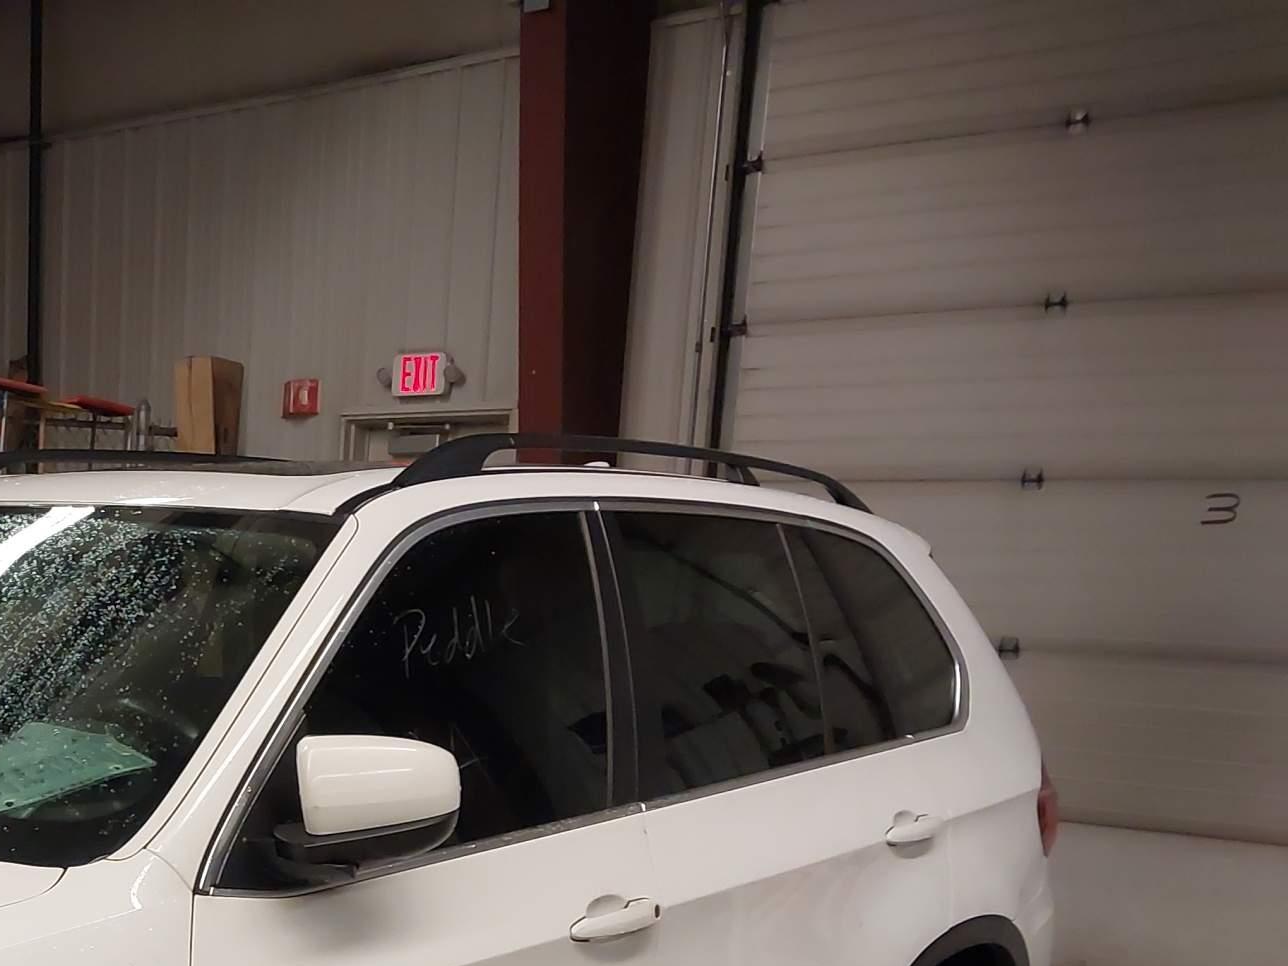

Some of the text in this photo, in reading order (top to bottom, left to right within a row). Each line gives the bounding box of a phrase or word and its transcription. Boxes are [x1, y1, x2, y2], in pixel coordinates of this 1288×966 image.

[400, 355, 440, 392] EXIT
[1200, 493, 1241, 525] 3
[393, 595, 527, 679] Peddle
